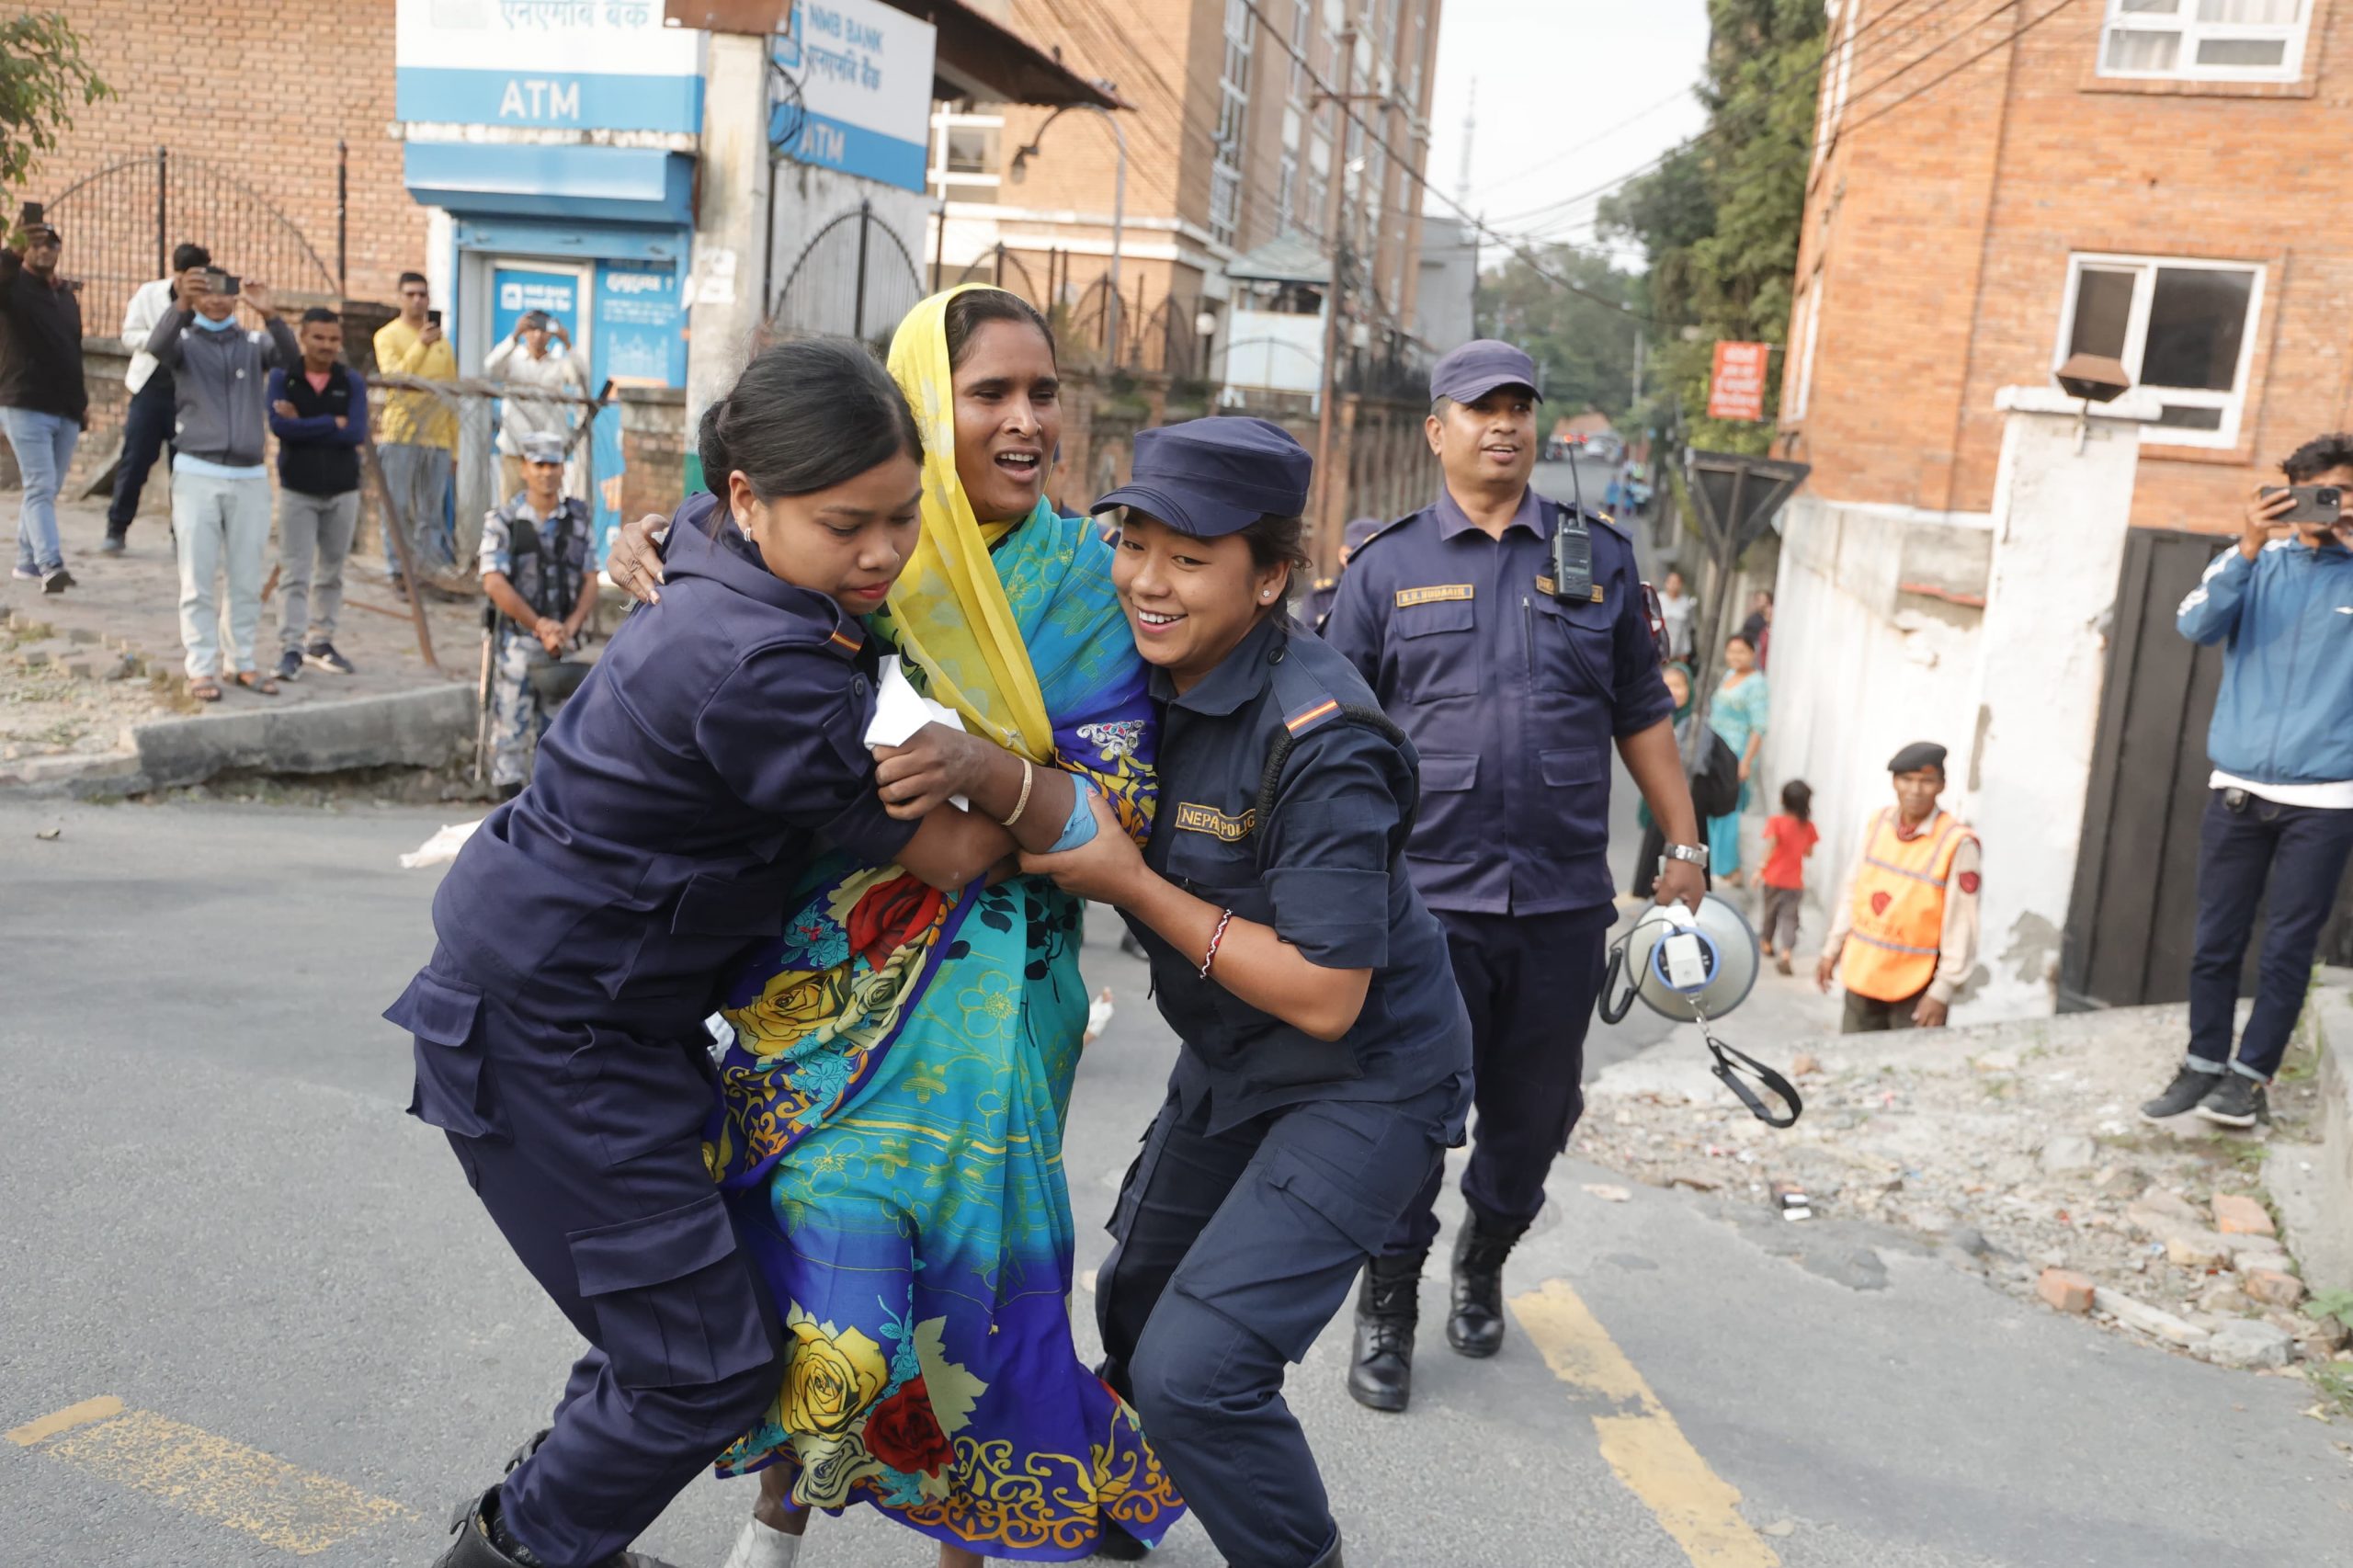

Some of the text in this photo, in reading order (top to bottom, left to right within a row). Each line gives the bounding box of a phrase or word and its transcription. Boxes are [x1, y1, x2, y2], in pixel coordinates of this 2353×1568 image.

[808, 4, 884, 53] NMB BANK
[498, 79, 581, 120] ATM
[799, 118, 846, 165] ATM
[1221, 815, 1256, 836] POLIC
